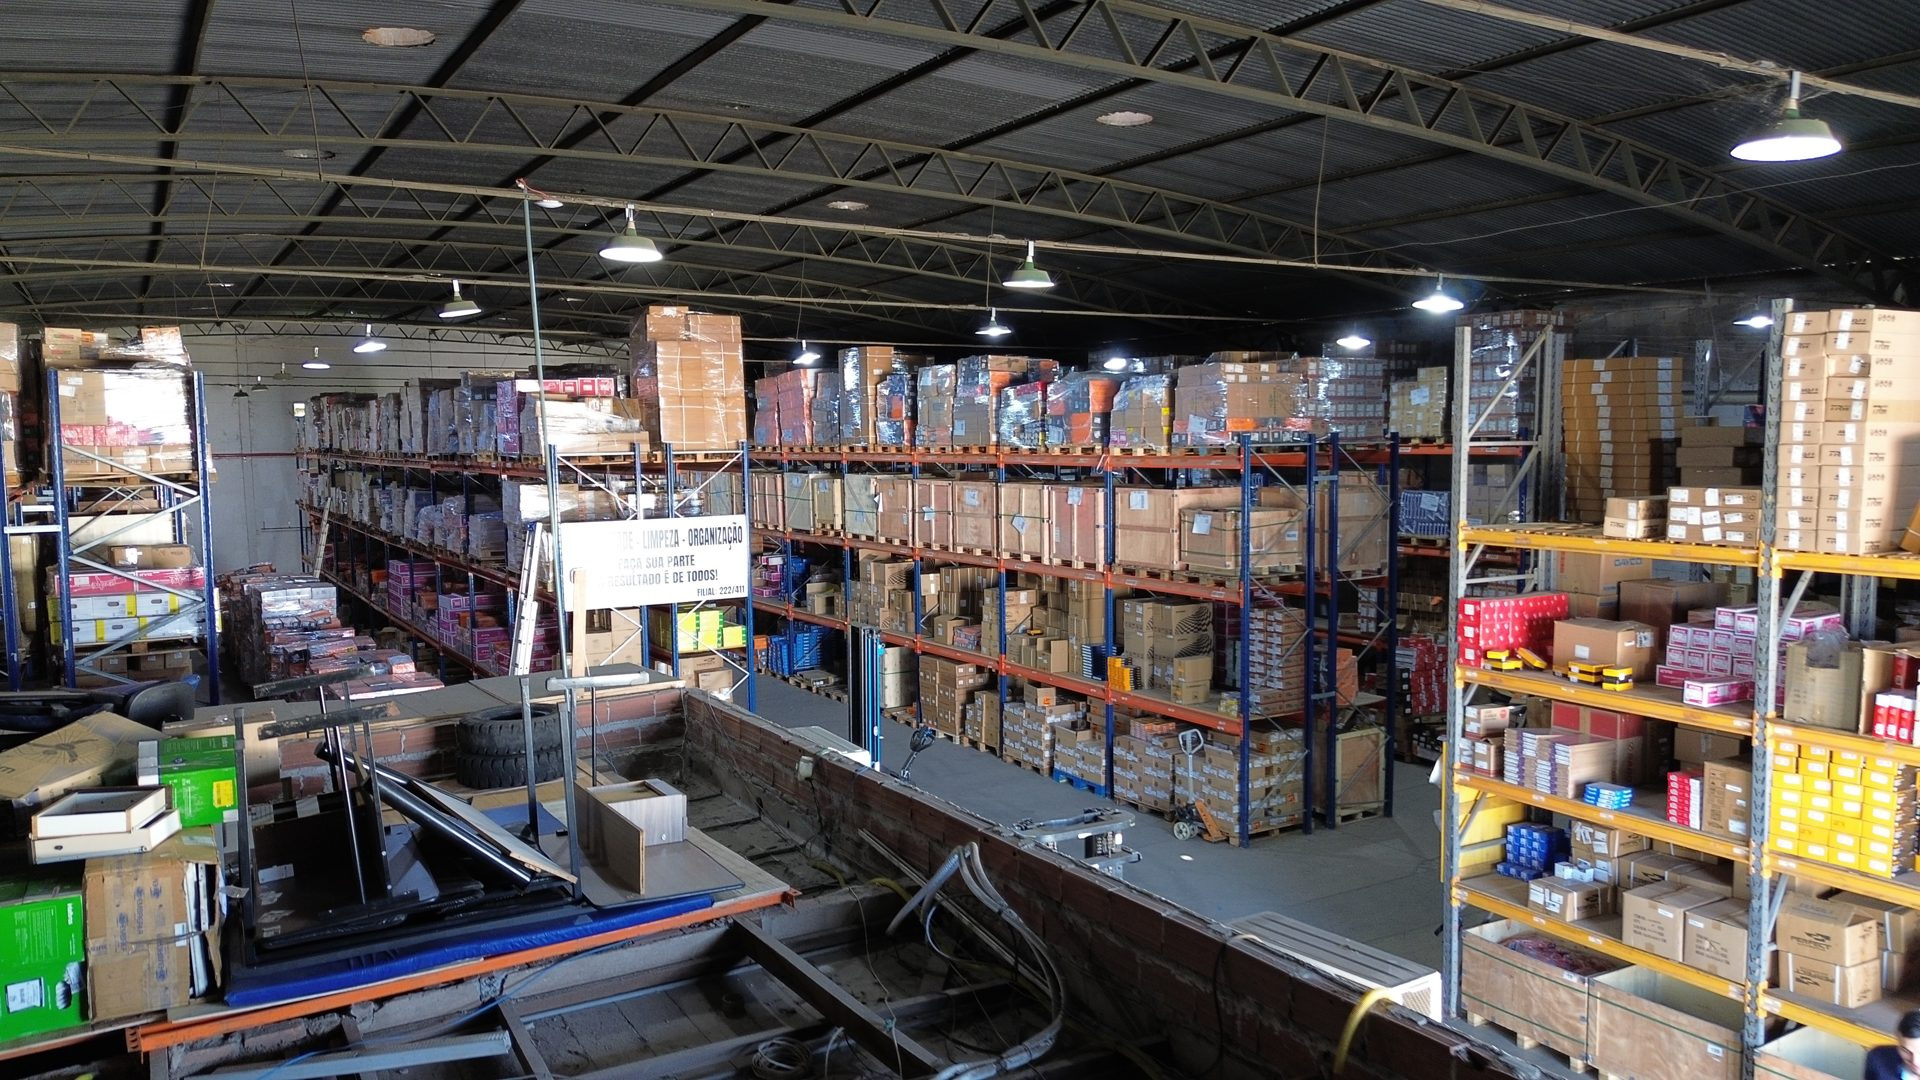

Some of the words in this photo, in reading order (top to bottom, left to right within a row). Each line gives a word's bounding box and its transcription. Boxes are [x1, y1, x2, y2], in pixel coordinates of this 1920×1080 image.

[642, 529, 680, 549] LIMPEZA
[688, 521, 743, 551] ORGANIZAÇÃO
[645, 556, 664, 569] SUA
[667, 554, 696, 568] PARTE
[664, 569, 670, 584] É
[673, 571, 684, 584] DE
[687, 568, 718, 583] TODOS!
[719, 584, 746, 596] 222/411
